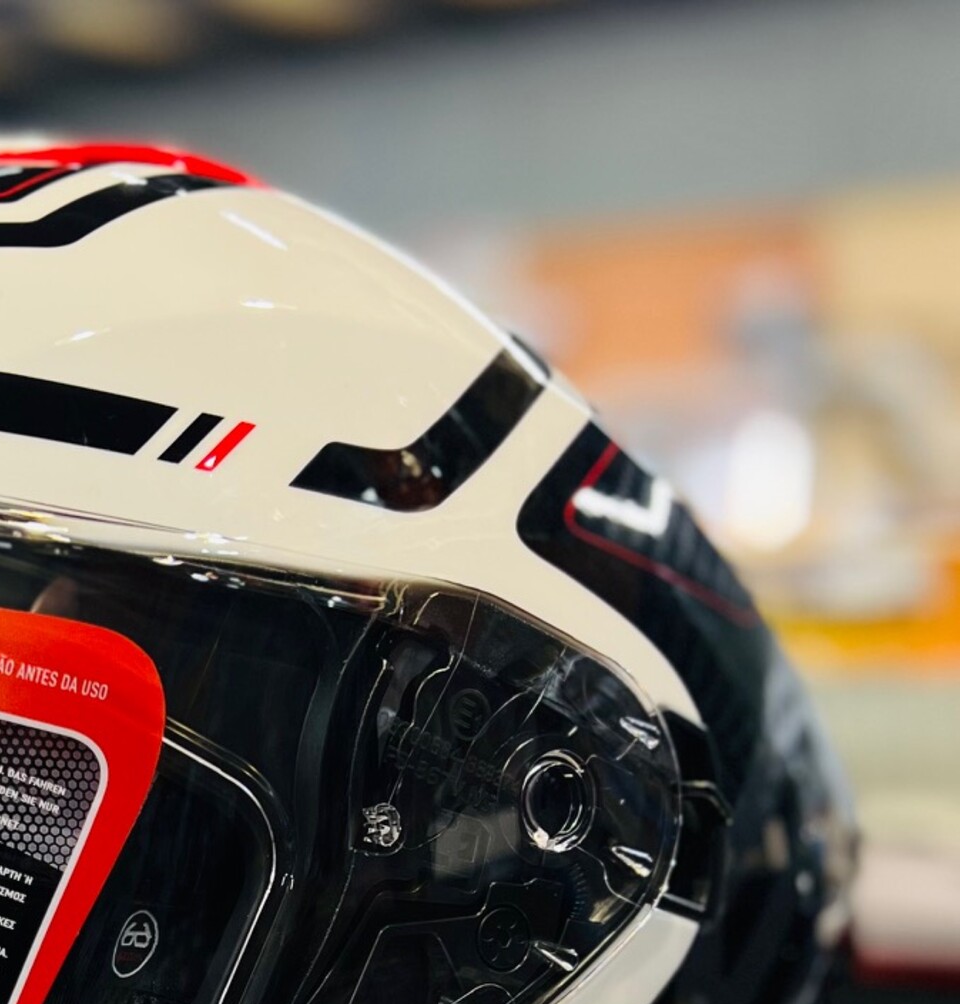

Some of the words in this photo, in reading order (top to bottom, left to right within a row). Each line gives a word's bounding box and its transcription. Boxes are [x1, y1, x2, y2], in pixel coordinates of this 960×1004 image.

[16, 662, 58, 688] ANTES
[60, 673, 78, 694] DA
[81, 679, 109, 701] USO
[6, 768, 26, 781] DAS
[27, 776, 65, 795] FAHREN
[20, 794, 36, 805] SIE
[37, 800, 59, 814] NUR
